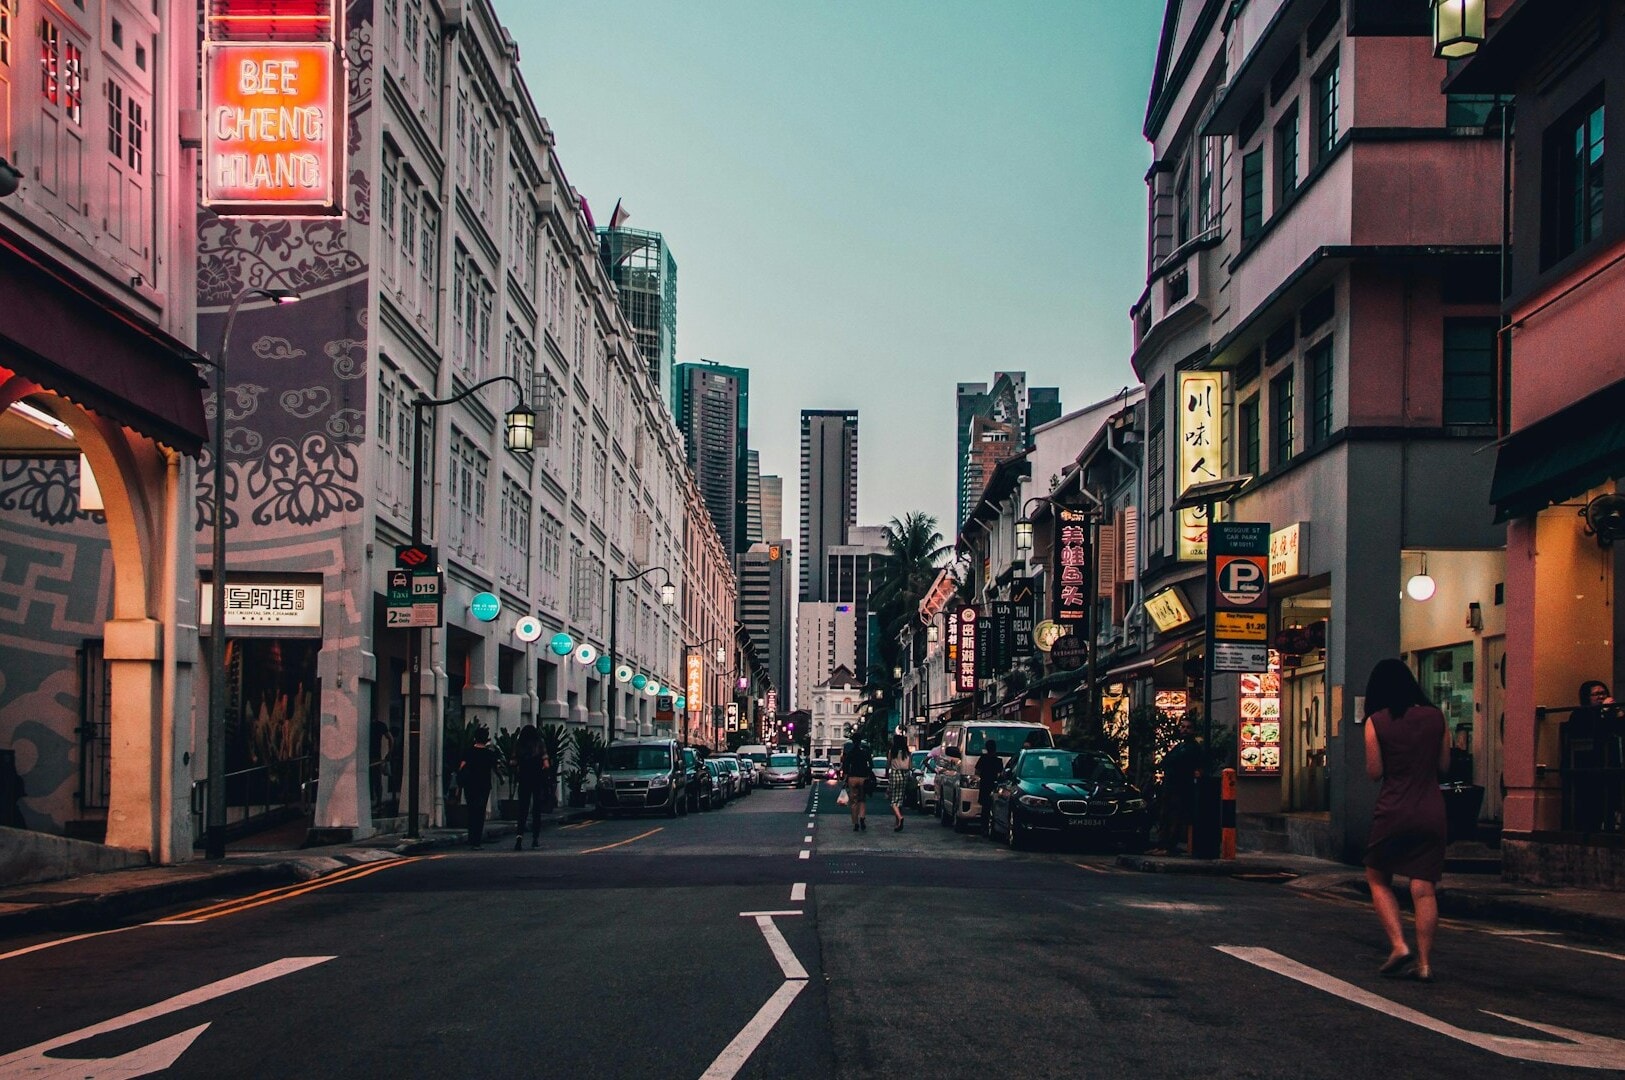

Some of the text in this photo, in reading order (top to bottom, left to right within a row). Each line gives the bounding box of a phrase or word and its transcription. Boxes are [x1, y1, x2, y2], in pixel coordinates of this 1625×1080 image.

[241, 59, 298, 95] BEE
[215, 105, 324, 141] CHENG
[216, 152, 321, 187] HIANG
[1271, 560, 1287, 577] BBQ
[1229, 563, 1260, 590] P
[392, 590, 409, 599] Taxi
[414, 583, 436, 593] D19
[388, 611, 398, 624] 2
[1015, 605, 1030, 618] THAI
[1012, 620, 1032, 632] RELAX
[1246, 622, 1266, 630] $1.20
[1016, 633, 1028, 646] SPA
